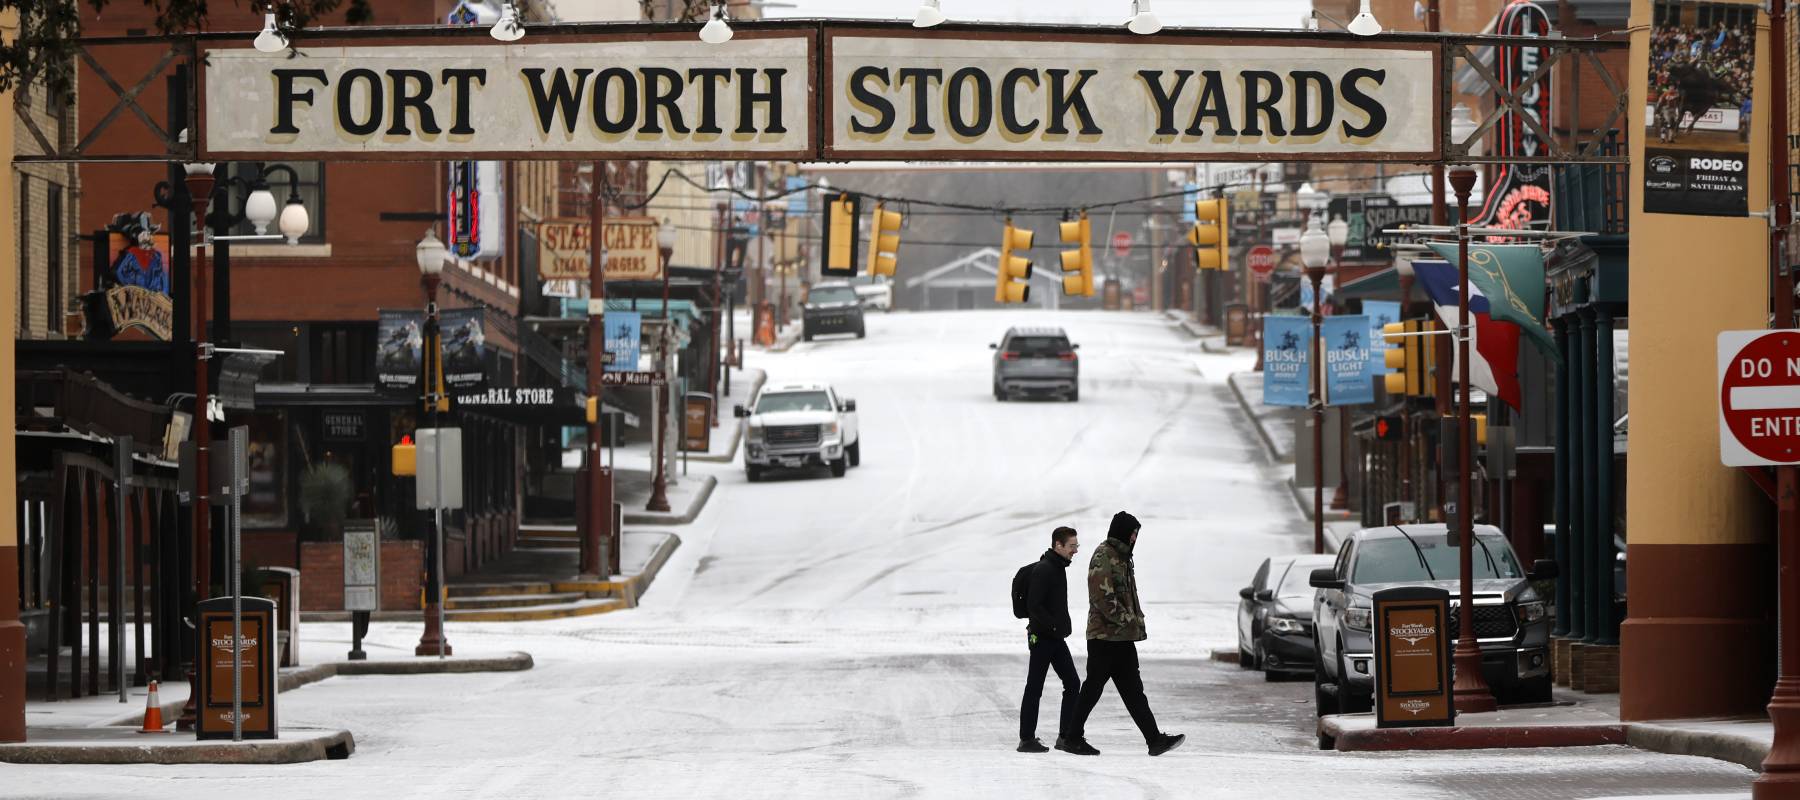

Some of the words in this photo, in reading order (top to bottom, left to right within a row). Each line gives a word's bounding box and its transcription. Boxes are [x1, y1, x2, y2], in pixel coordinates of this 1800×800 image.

[268, 68, 487, 138] FORT
[520, 66, 788, 137] WORTH
[848, 65, 1103, 138] STOCK
[1137, 67, 1387, 139] YARDS
[1690, 157, 1744, 172] RODEO
[1696, 174, 1729, 182] FRIDAY
[1691, 183, 1743, 191] SATURDAYS
[604, 224, 653, 249] CAFE
[606, 256, 647, 272] URGERS
[1248, 255, 1273, 265] STOP
[1265, 350, 1307, 363] BUSCH
[1327, 349, 1369, 363] BUSCH
[1269, 361, 1300, 372] LIGHT
[1332, 360, 1363, 372] LIGHT
[1740, 358, 1772, 378] DO
[614, 372, 622, 383] N
[626, 372, 650, 384] Main
[515, 388, 554, 405] STORE
[1390, 626, 1435, 636] STOCKYARDS
